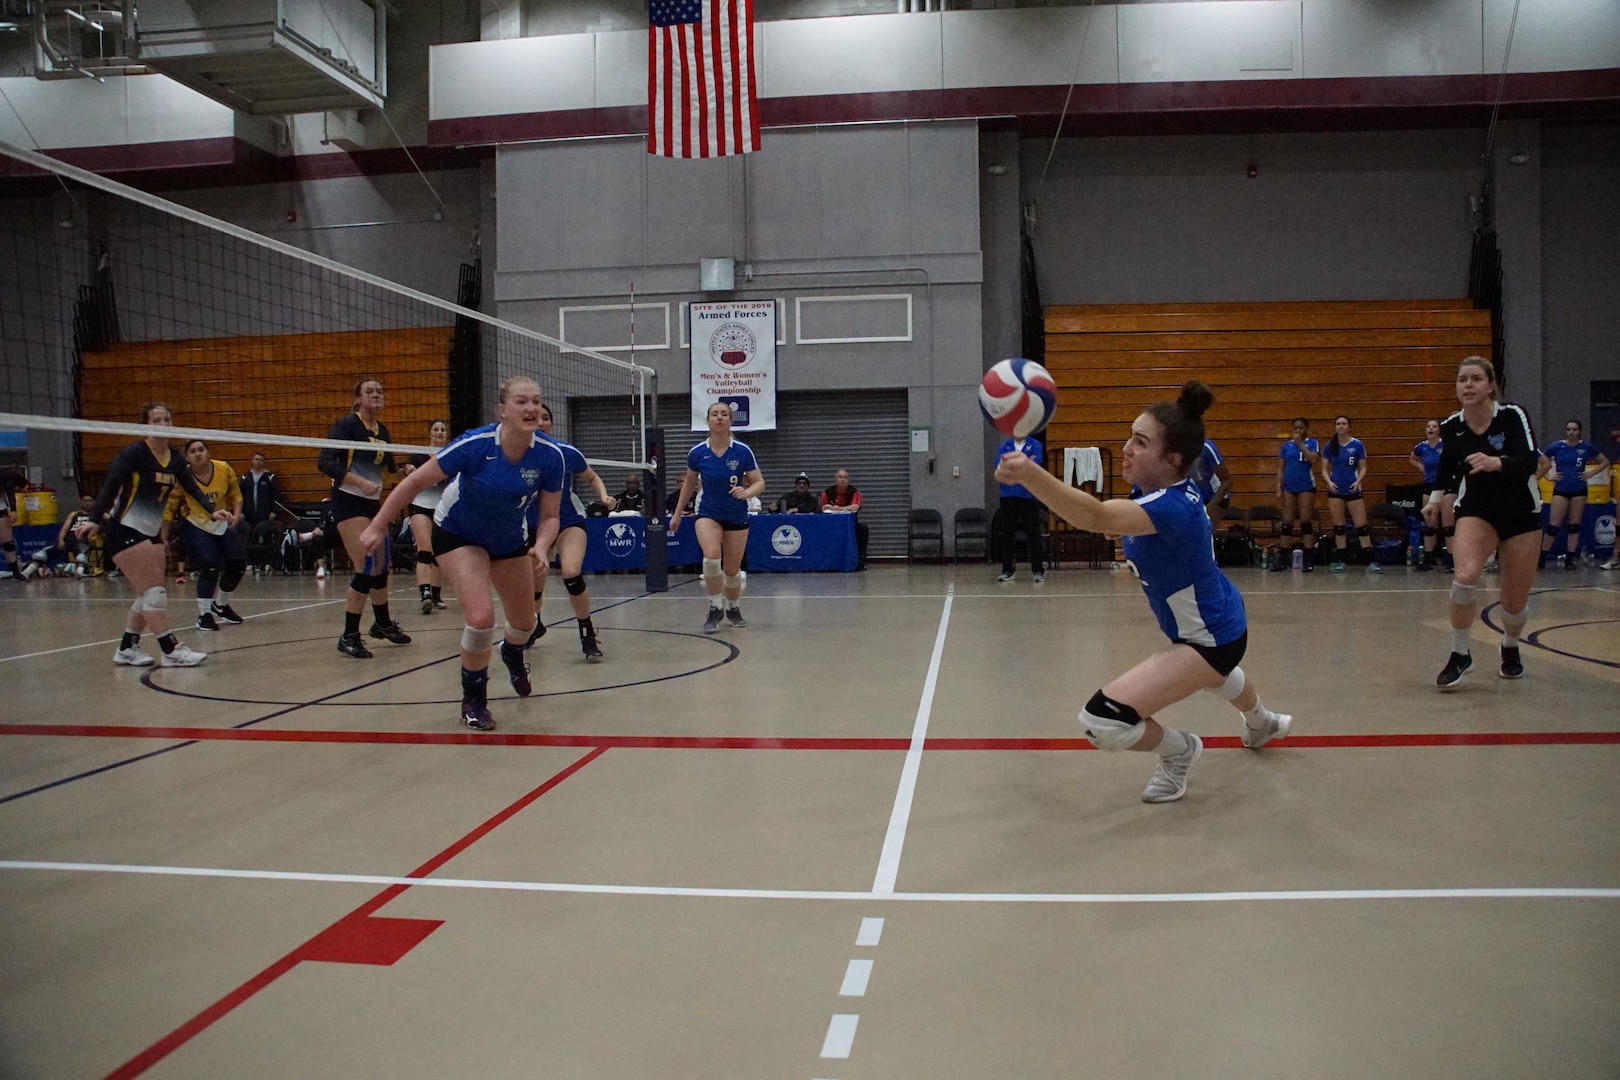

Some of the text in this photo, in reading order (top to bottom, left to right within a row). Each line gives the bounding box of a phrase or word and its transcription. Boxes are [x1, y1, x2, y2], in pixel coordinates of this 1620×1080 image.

[734, 310, 767, 318] Forces
[732, 324, 749, 334] ARMED
[732, 371, 767, 379] Women's
[715, 379, 753, 388] Volleyball
[706, 386, 761, 395] Championship
[1349, 456, 1355, 465] 6
[1576, 458, 1583, 467] 5
[729, 475, 738, 487] 9
[158, 485, 169, 502] 7
